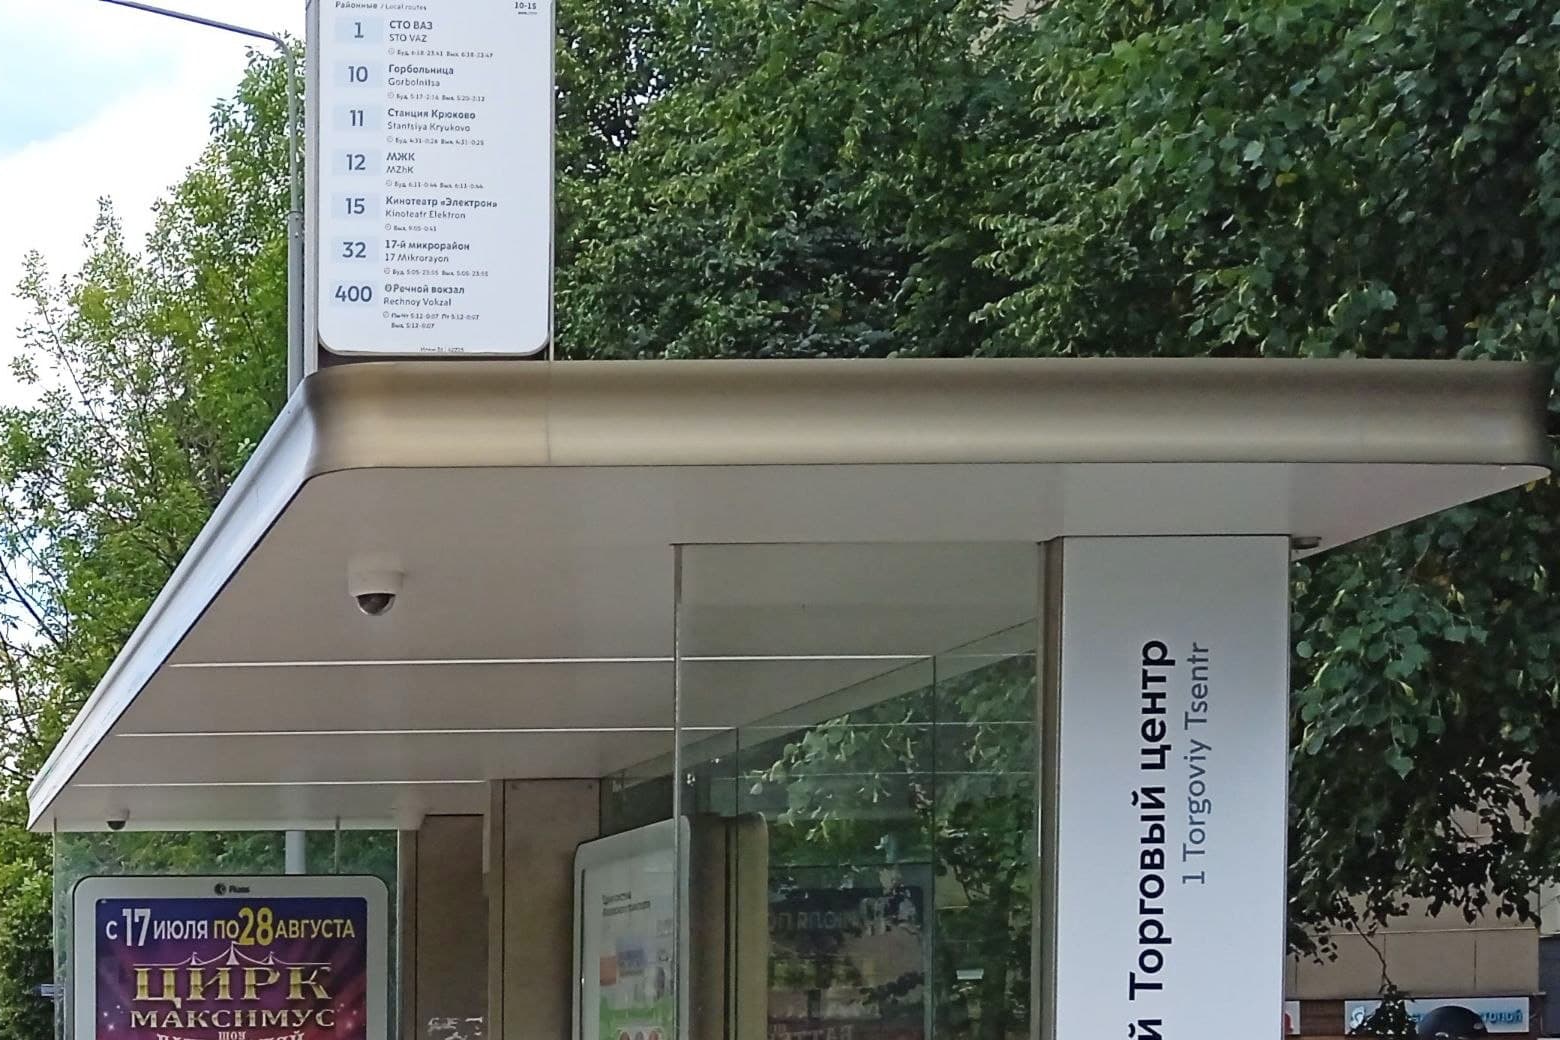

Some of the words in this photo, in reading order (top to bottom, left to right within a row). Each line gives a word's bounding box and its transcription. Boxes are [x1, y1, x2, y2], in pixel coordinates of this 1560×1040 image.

[335, 0, 378, 9] Районные
[354, 22, 364, 39] 1
[389, 20, 411, 30] СТО
[413, 20, 433, 31] ВАЗ
[389, 33, 407, 43] STO
[409, 34, 428, 43] VAZ
[348, 65, 369, 83] 10
[388, 64, 454, 76] Горбольница
[388, 77, 441, 88] Gorbolnitsa
[350, 109, 364, 126] 11
[387, 108, 429, 119] Станция
[431, 109, 476, 120] Крюково
[387, 121, 428, 132] Stantsiya
[429, 123, 471, 133] Kryukovo
[346, 154, 367, 171] 12
[386, 152, 416, 162] МЖК
[385, 165, 414, 174] MZhK
[345, 197, 366, 215] 15
[385, 195, 438, 207] Кинотеатр
[440, 197, 498, 209] «Электрон»
[385, 209, 427, 218] Kinoteatr
[429, 210, 466, 219] Elektron
[342, 241, 367, 259] 32
[385, 240, 406, 249] 17-й
[408, 241, 470, 252] микрорайон
[385, 253, 396, 261] 17
[397, 254, 449, 264] Mikrorayon
[334, 285, 372, 302] 400
[431, 286, 465, 294] вокзал
[383, 296, 420, 307] Rechnoy
[422, 298, 452, 307] Vokzal
[1184, 641, 1209, 730] Tsentr
[1139, 638, 1176, 771] центр
[1182, 737, 1212, 862] Torgoviy
[1182, 870, 1206, 885] 1
[1128, 785, 1172, 1001] Торговый
[122, 907, 152, 947] 17
[153, 919, 209, 940] ИЮЛЯ
[213, 919, 239, 940] ПО
[238, 906, 274, 947] 28
[274, 917, 356, 939] АВГУСТА
[131, 966, 333, 1009] ЦИРК
[218, 1030, 247, 1040] ШОУ
